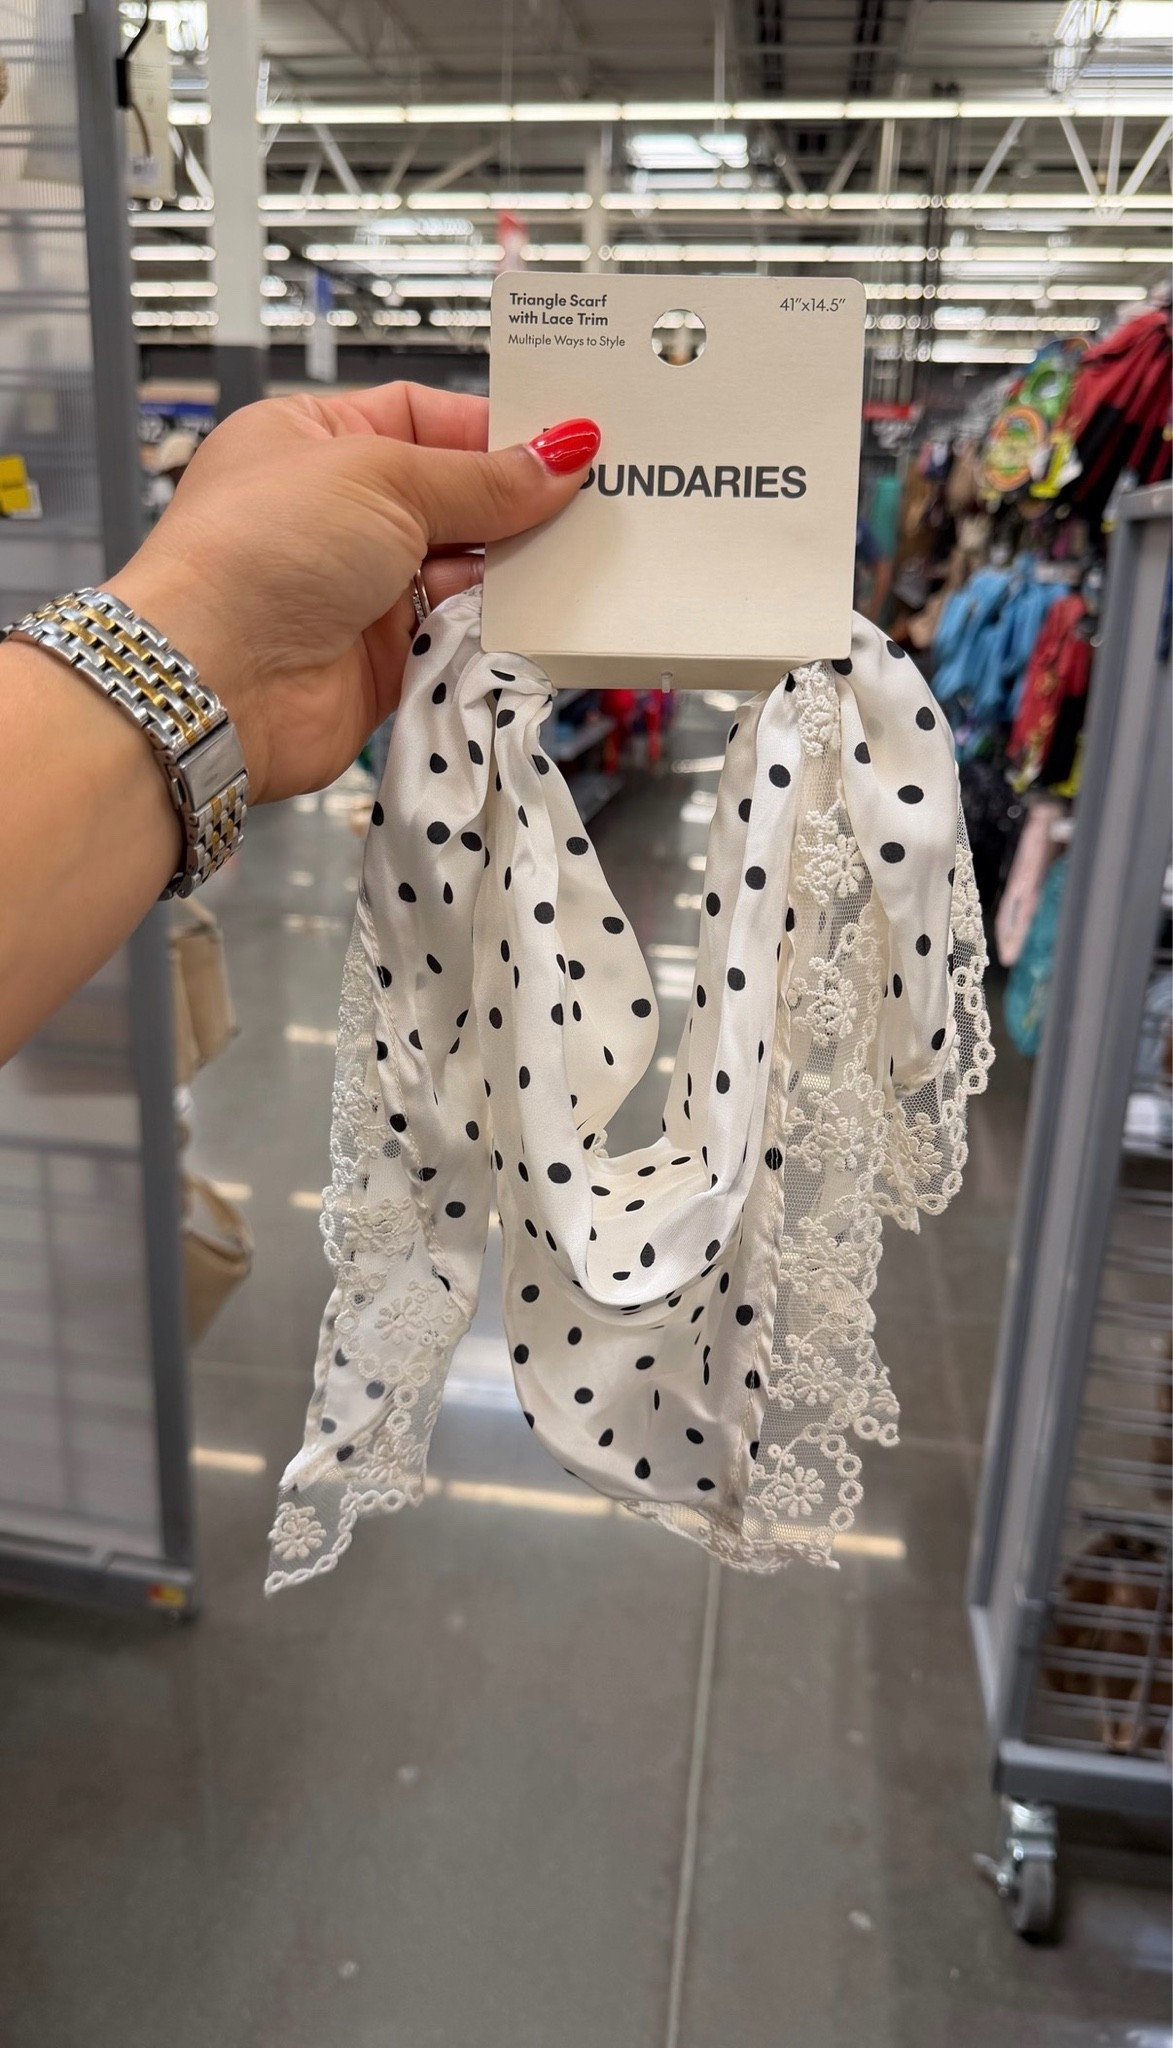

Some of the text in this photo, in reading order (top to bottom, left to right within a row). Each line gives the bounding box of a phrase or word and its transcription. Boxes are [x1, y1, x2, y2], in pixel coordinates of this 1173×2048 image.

[509, 292, 608, 310] Triangle Scarf
[508, 310, 609, 326] with Lace Trim
[508, 333, 626, 349] Multiple Ways to Style
